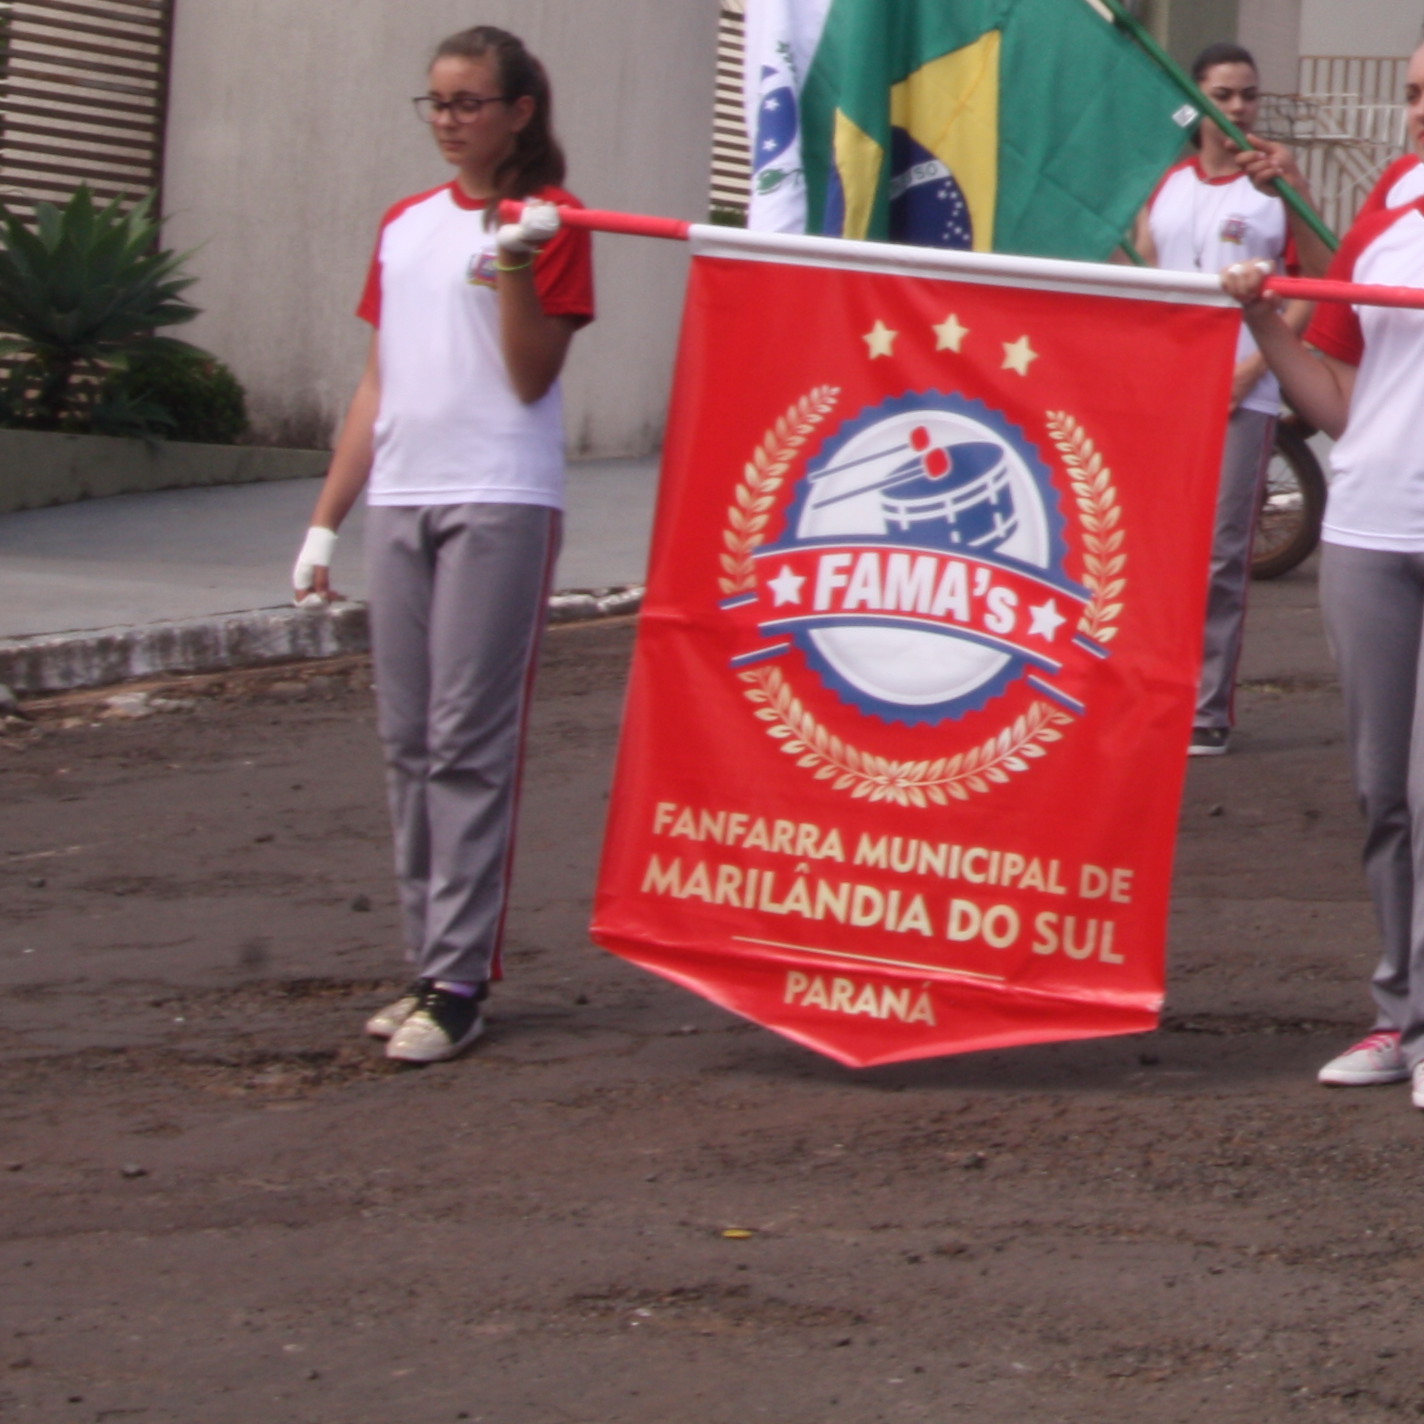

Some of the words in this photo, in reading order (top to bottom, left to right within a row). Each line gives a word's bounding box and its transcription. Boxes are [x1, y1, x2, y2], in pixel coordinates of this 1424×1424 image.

[812, 552, 1017, 636] FAMA's
[653, 801, 846, 863] FANFARRA
[853, 832, 1067, 895] MUNICIPAL
[1078, 863, 1135, 904] DE
[641, 855, 934, 937] MARILÂNDIA
[946, 898, 1020, 949] DO
[1031, 910, 1125, 965] SUL
[783, 971, 936, 1026] PARANÁ
